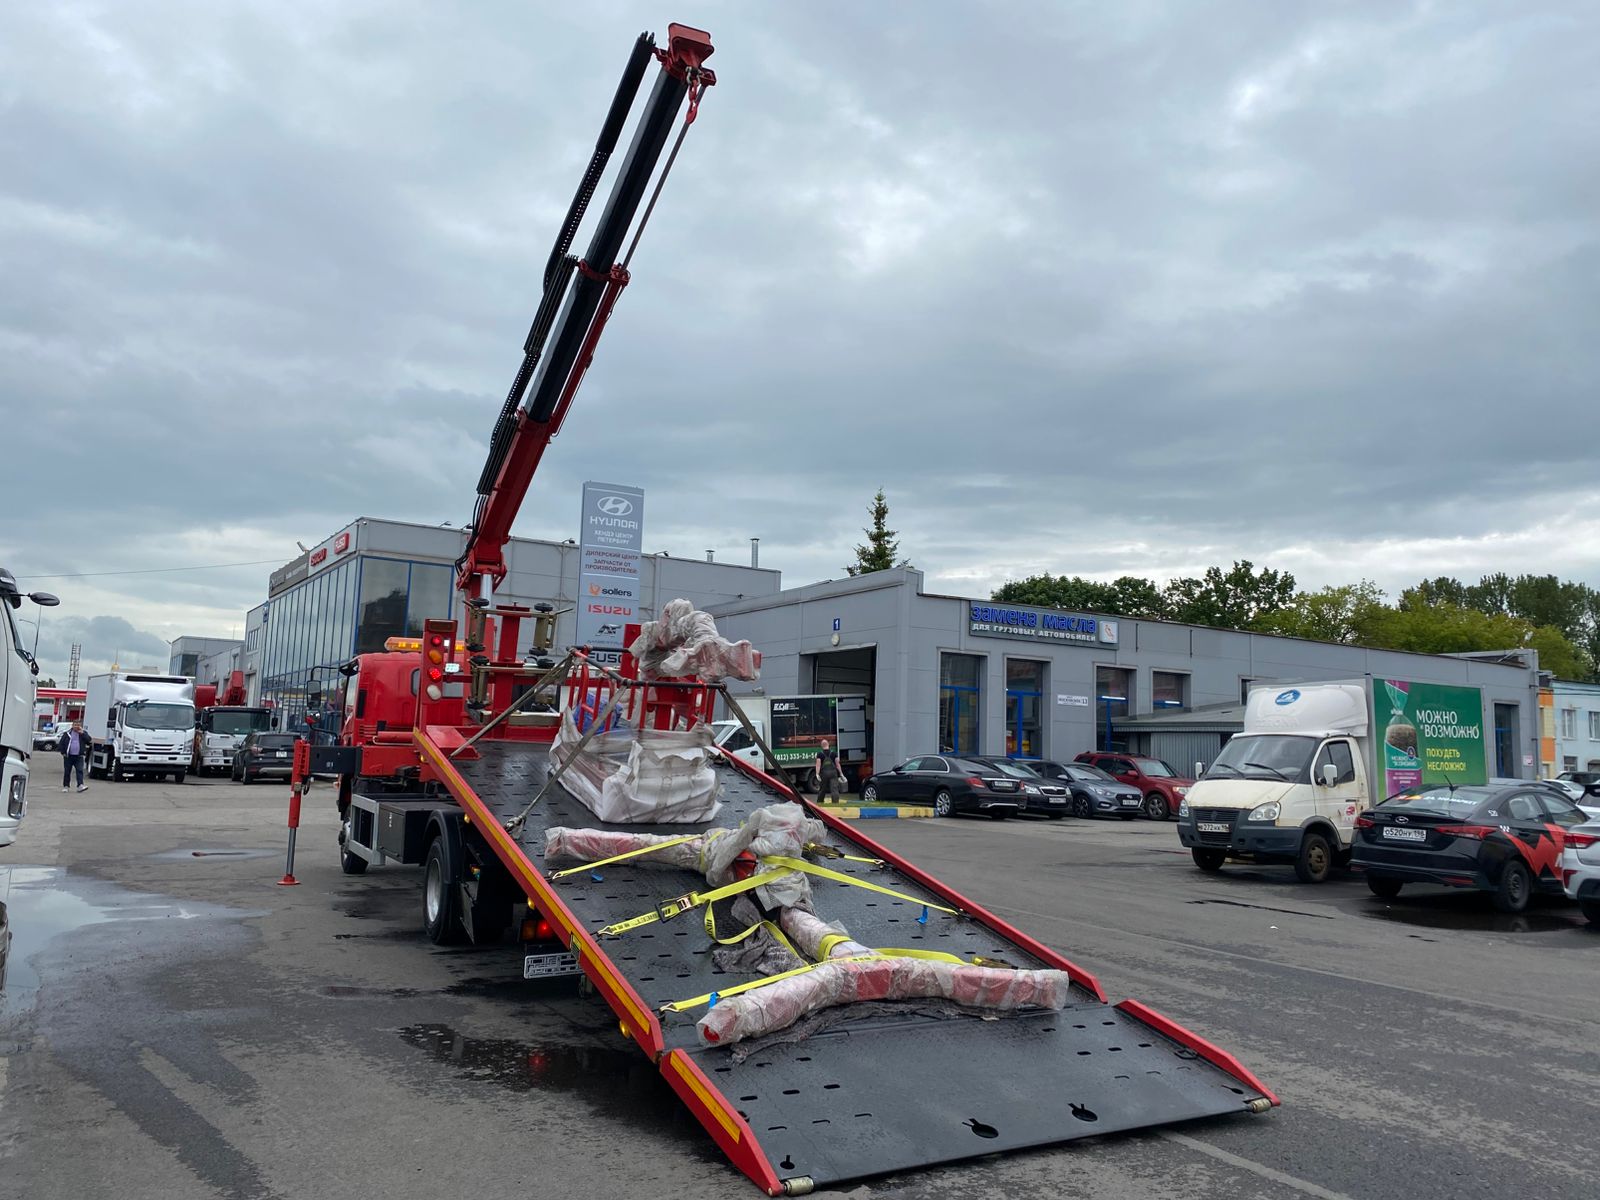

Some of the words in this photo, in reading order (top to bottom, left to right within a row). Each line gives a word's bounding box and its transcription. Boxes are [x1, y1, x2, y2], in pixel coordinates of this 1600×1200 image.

[589, 515, 639, 530] HYUNDAI
[597, 536, 630, 545] ПЕТЕРБУРГ
[615, 532, 634, 540] ЦЕНТР
[585, 550, 621, 559] ДИЛЕРСКИЙ
[621, 552, 639, 561] ЦЕНТР
[594, 558, 623, 567] ЗАПЧАСТИ
[585, 564, 637, 574] ПРОИЗВОДИТЕЛЕЙ
[602, 587, 632, 597] sollers
[588, 604, 632, 616] ISUZU
[972, 623, 990, 631] ДЛЯ
[993, 625, 1035, 636] ГРУЗОВЫХ
[588, 652, 622, 663] FUS
[1416, 709, 1458, 724] МОЖНО
[1424, 725, 1479, 739] ВОЗМОЖНО
[774, 753, 789, 761] (812)
[1426, 748, 1461, 759] ПОХУДЕТЬ
[1427, 761, 1467, 771] НЕСЛОЖНО!
